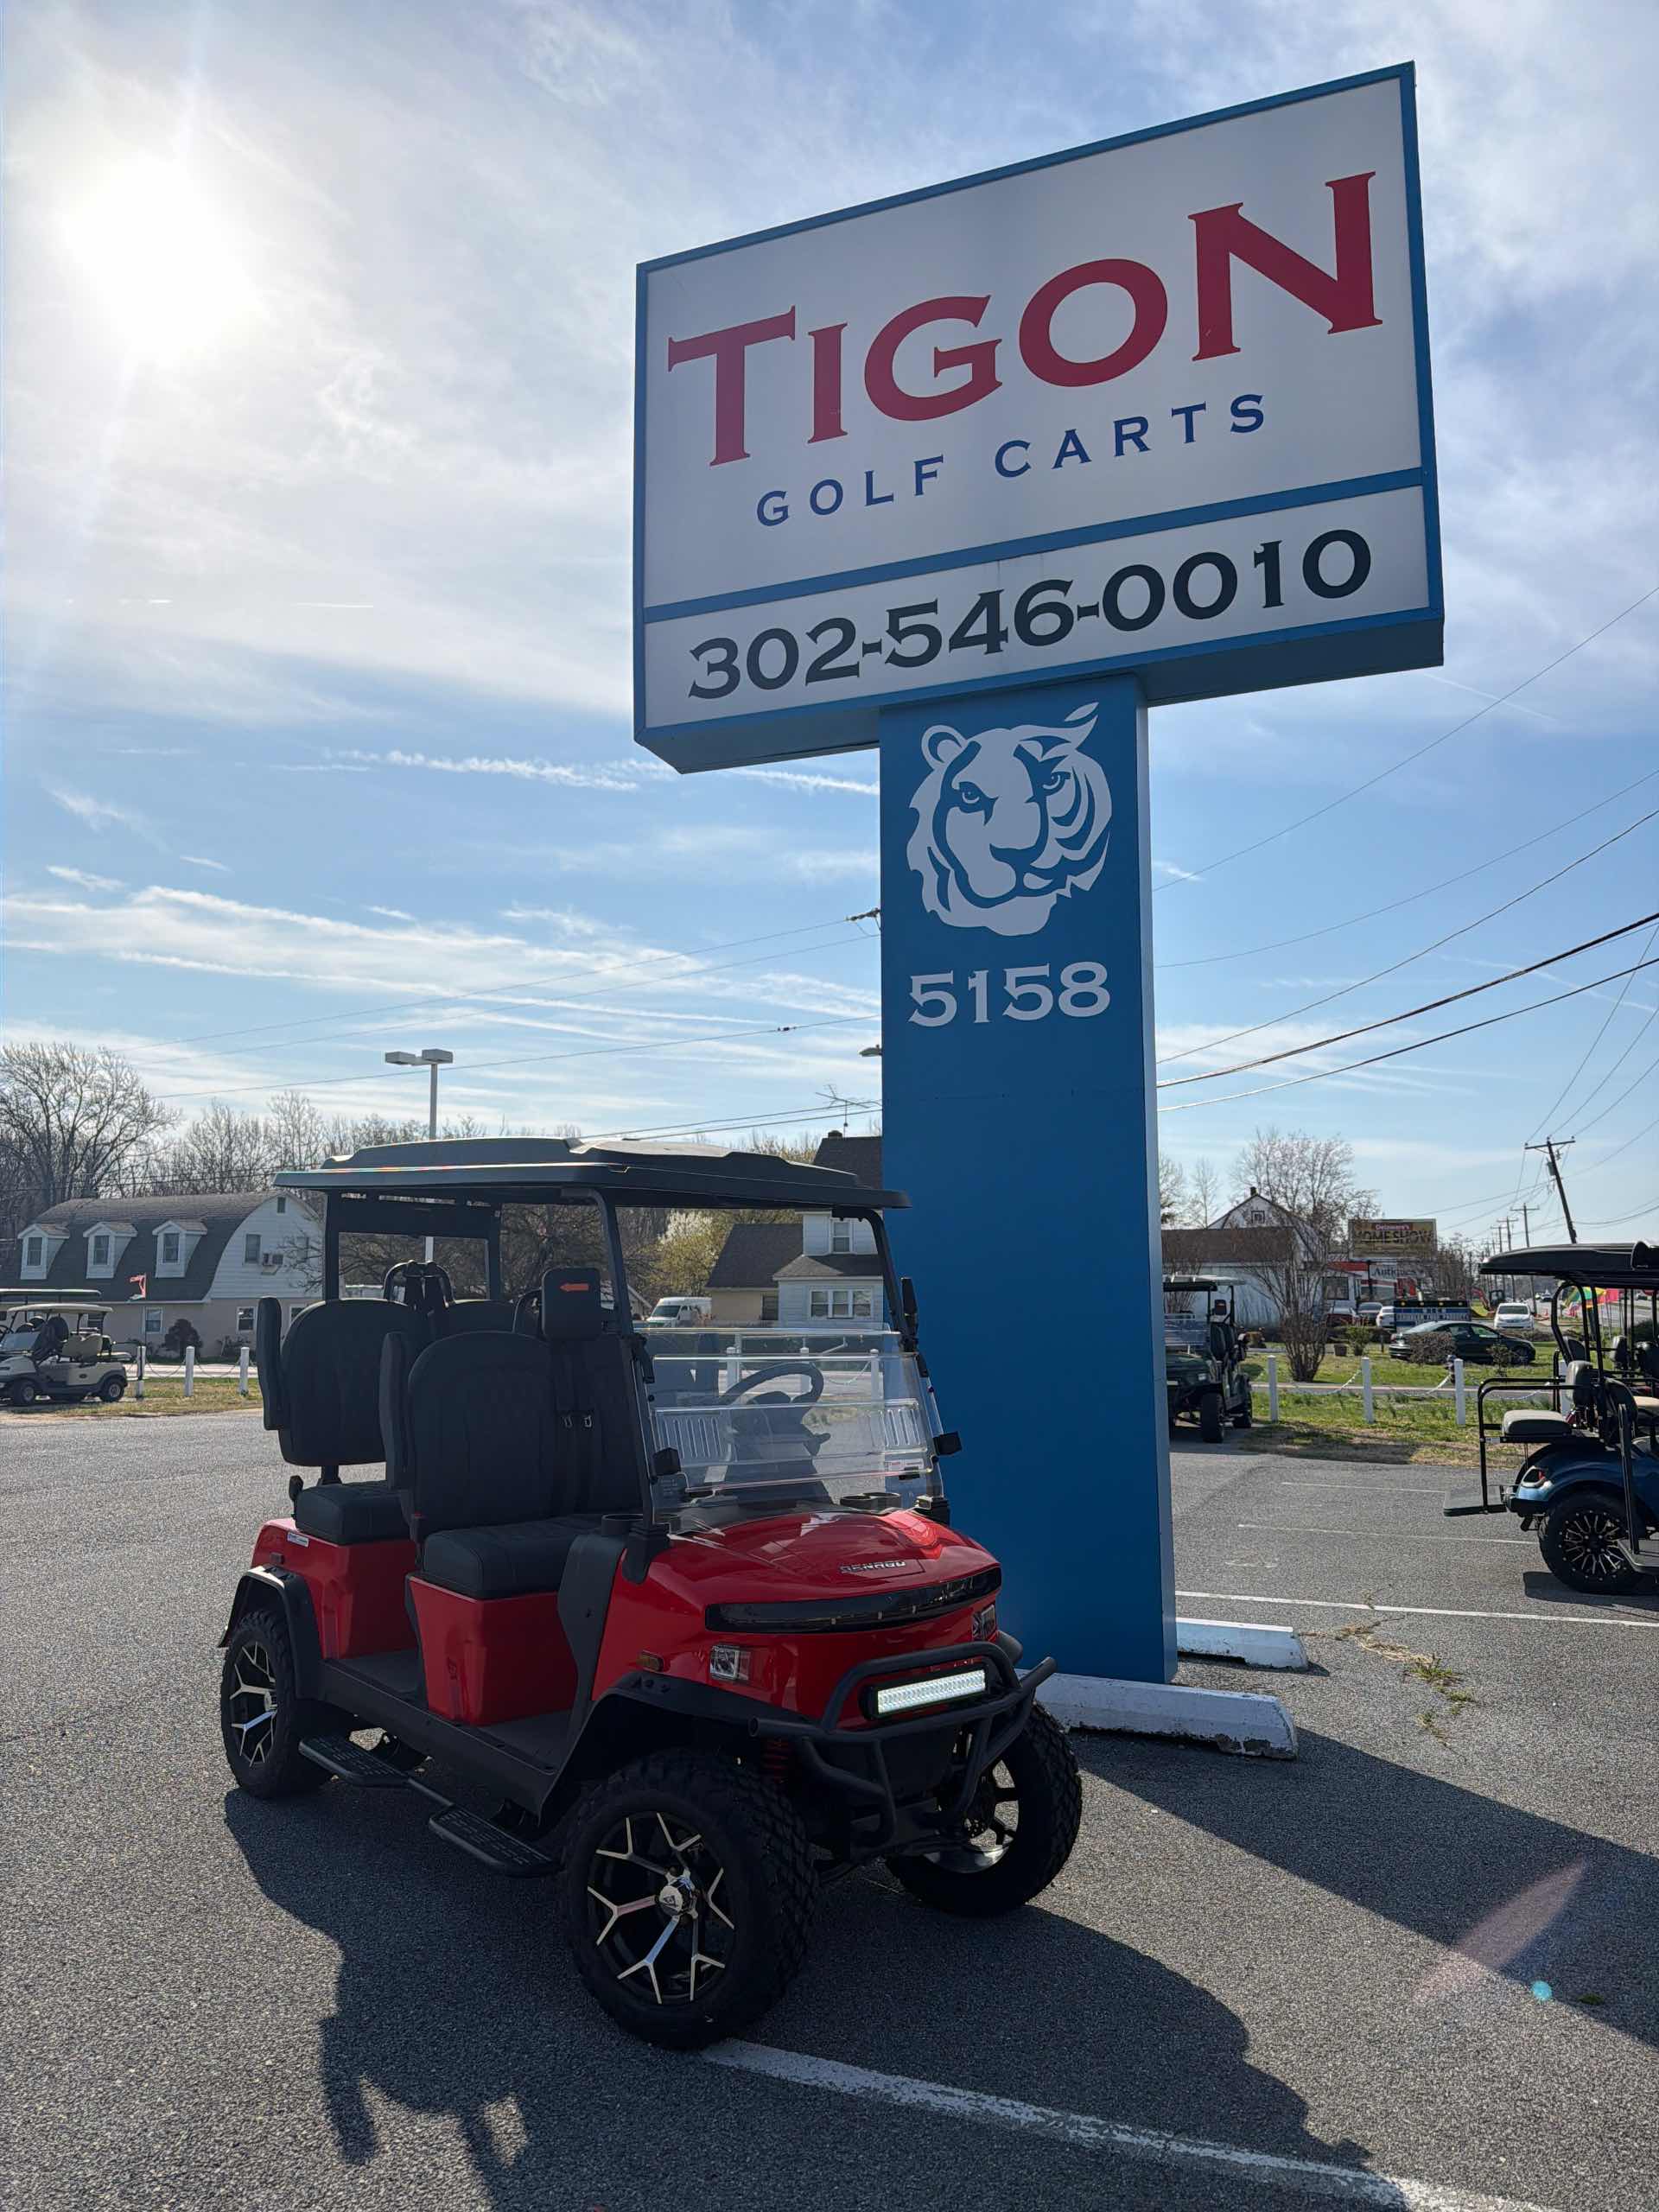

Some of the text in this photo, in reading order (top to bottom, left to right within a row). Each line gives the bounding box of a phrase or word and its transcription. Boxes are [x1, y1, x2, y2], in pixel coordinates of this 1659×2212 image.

[668, 171, 1383, 467] TIGON
[757, 393, 1265, 526] GOLF CARTS
[689, 530, 1371, 699] 302-546-0010
[908, 962, 1110, 1027] 5158
